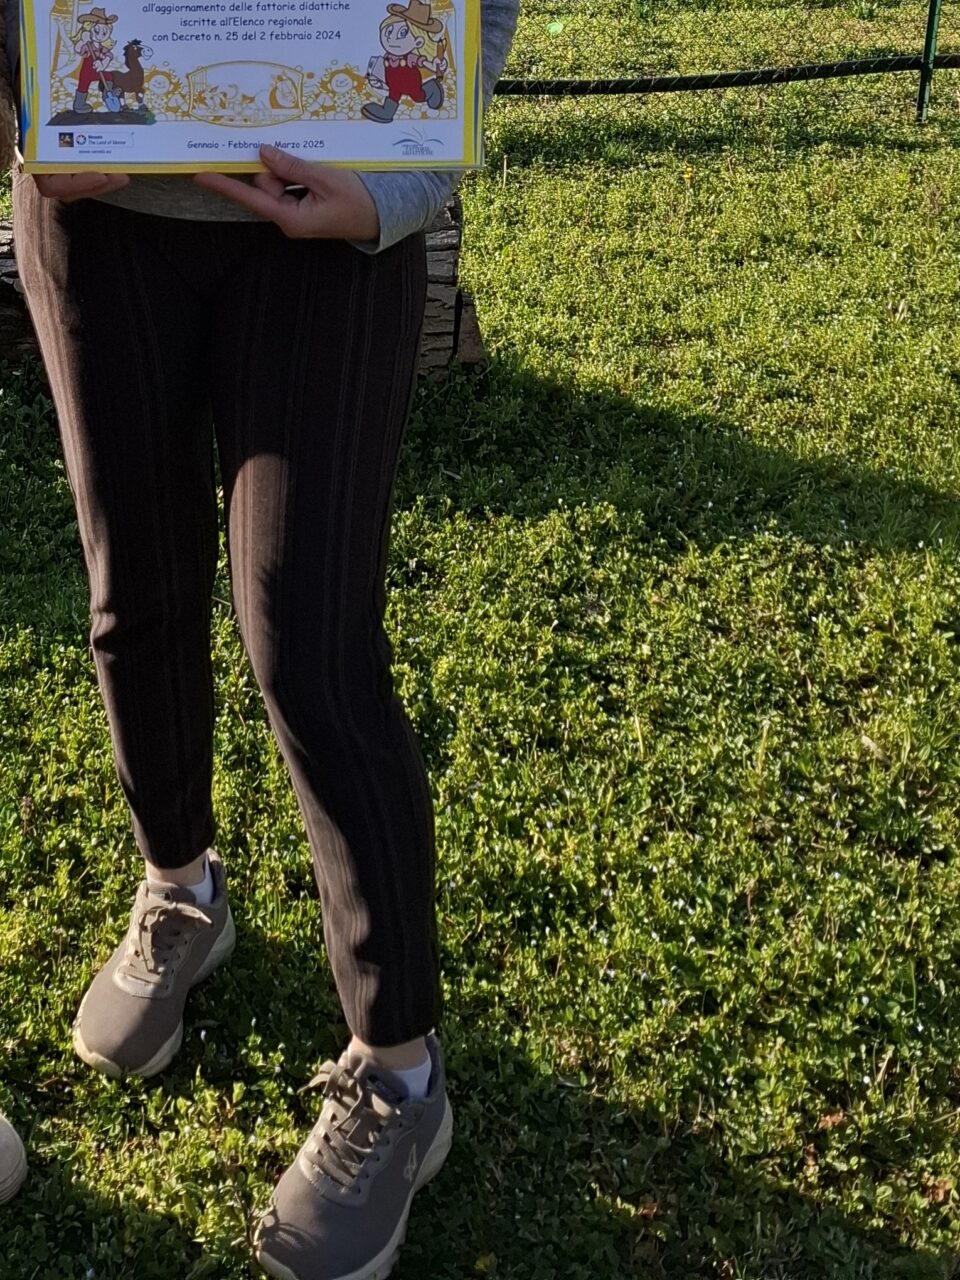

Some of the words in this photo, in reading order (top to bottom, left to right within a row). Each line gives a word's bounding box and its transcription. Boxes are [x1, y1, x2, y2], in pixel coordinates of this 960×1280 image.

[228, 2, 253, 12] delle
[256, 1, 296, 11] fattorie
[298, 0, 350, 11] didattiche
[180, 17, 217, 27] iscritte
[267, 16, 313, 28] regionale
[152, 33, 169, 42] con
[171, 32, 212, 42] Decreto
[214, 33, 223, 41] n.
[225, 31, 239, 41] 25
[241, 31, 257, 41] del
[259, 31, 266, 41] 2
[269, 30, 312, 41] febbraio
[315, 30, 341, 40] 2024
[187, 140, 219, 149] Gennaio
[228, 140, 264, 149] Febbrai
[273, 140, 300, 149] Marzo
[303, 139, 325, 148] 2025
